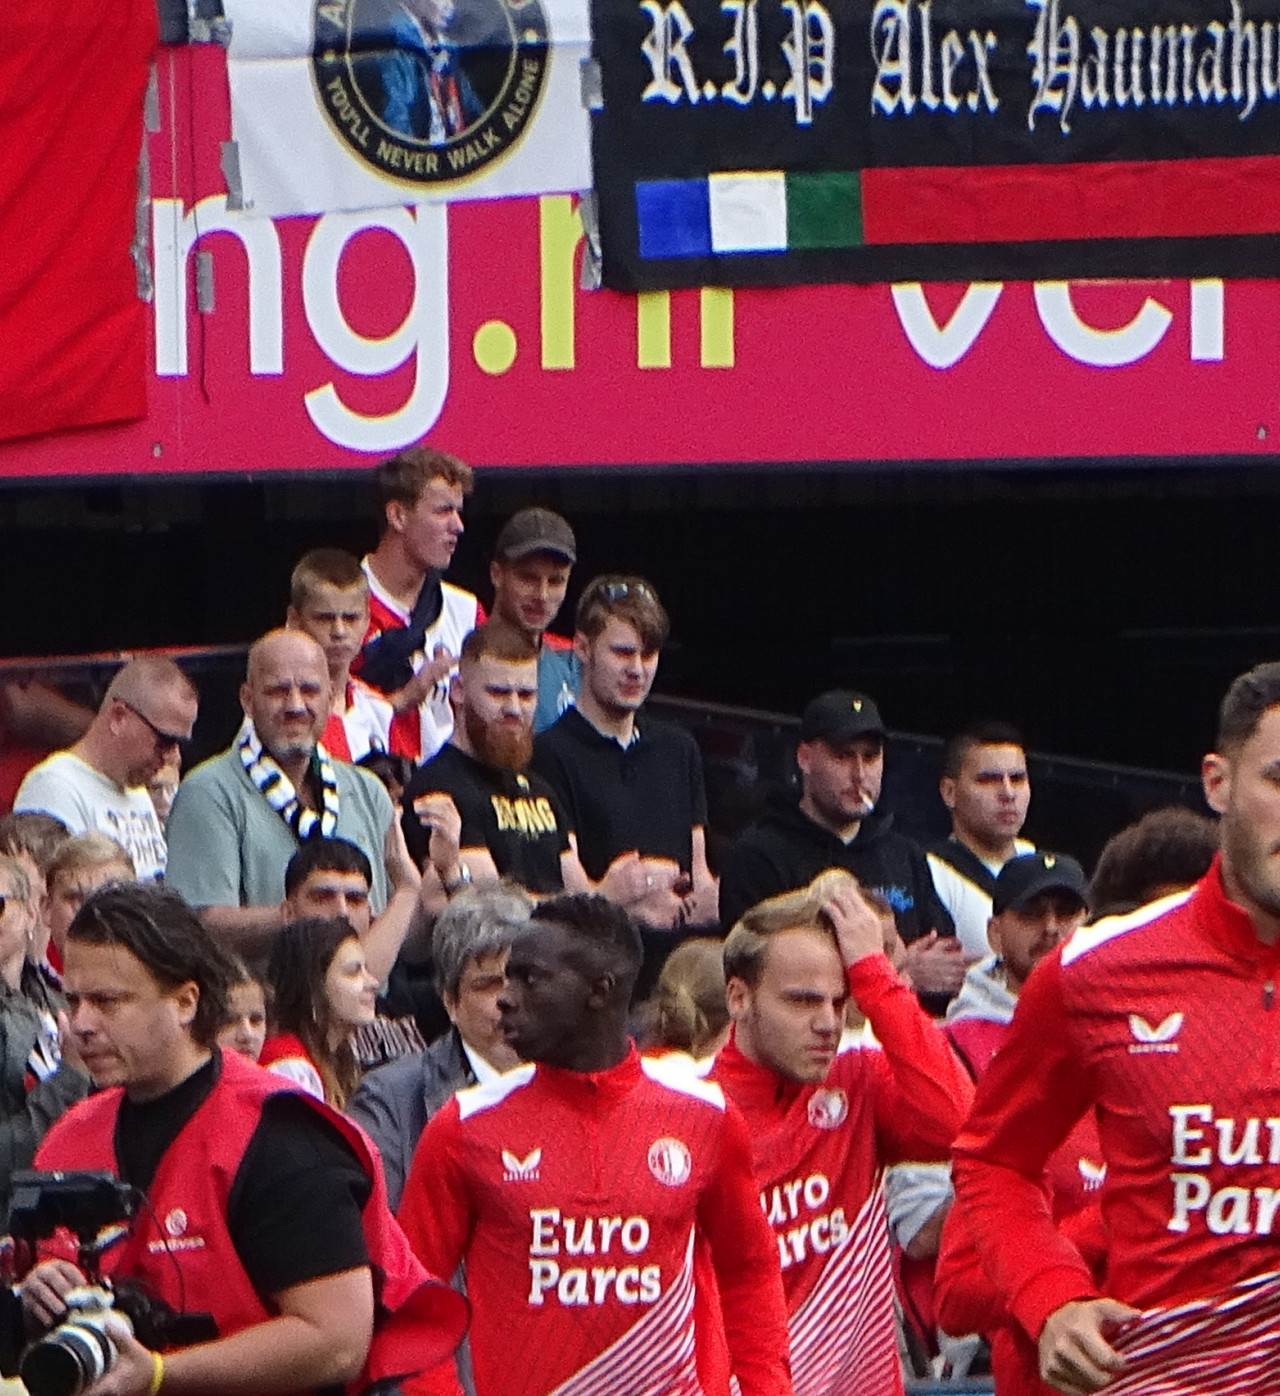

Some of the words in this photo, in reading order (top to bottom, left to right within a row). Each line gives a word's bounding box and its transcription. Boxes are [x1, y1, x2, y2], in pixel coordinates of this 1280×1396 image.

[871, 0, 999, 116] Alex
[376, 138, 440, 174] NEVER
[446, 126, 502, 171] WALK
[502, 57, 540, 131] ALONE
[760, 1171, 830, 1226] uro
[529, 1207, 650, 1256] Euro
[528, 1257, 662, 1306] Parcs
